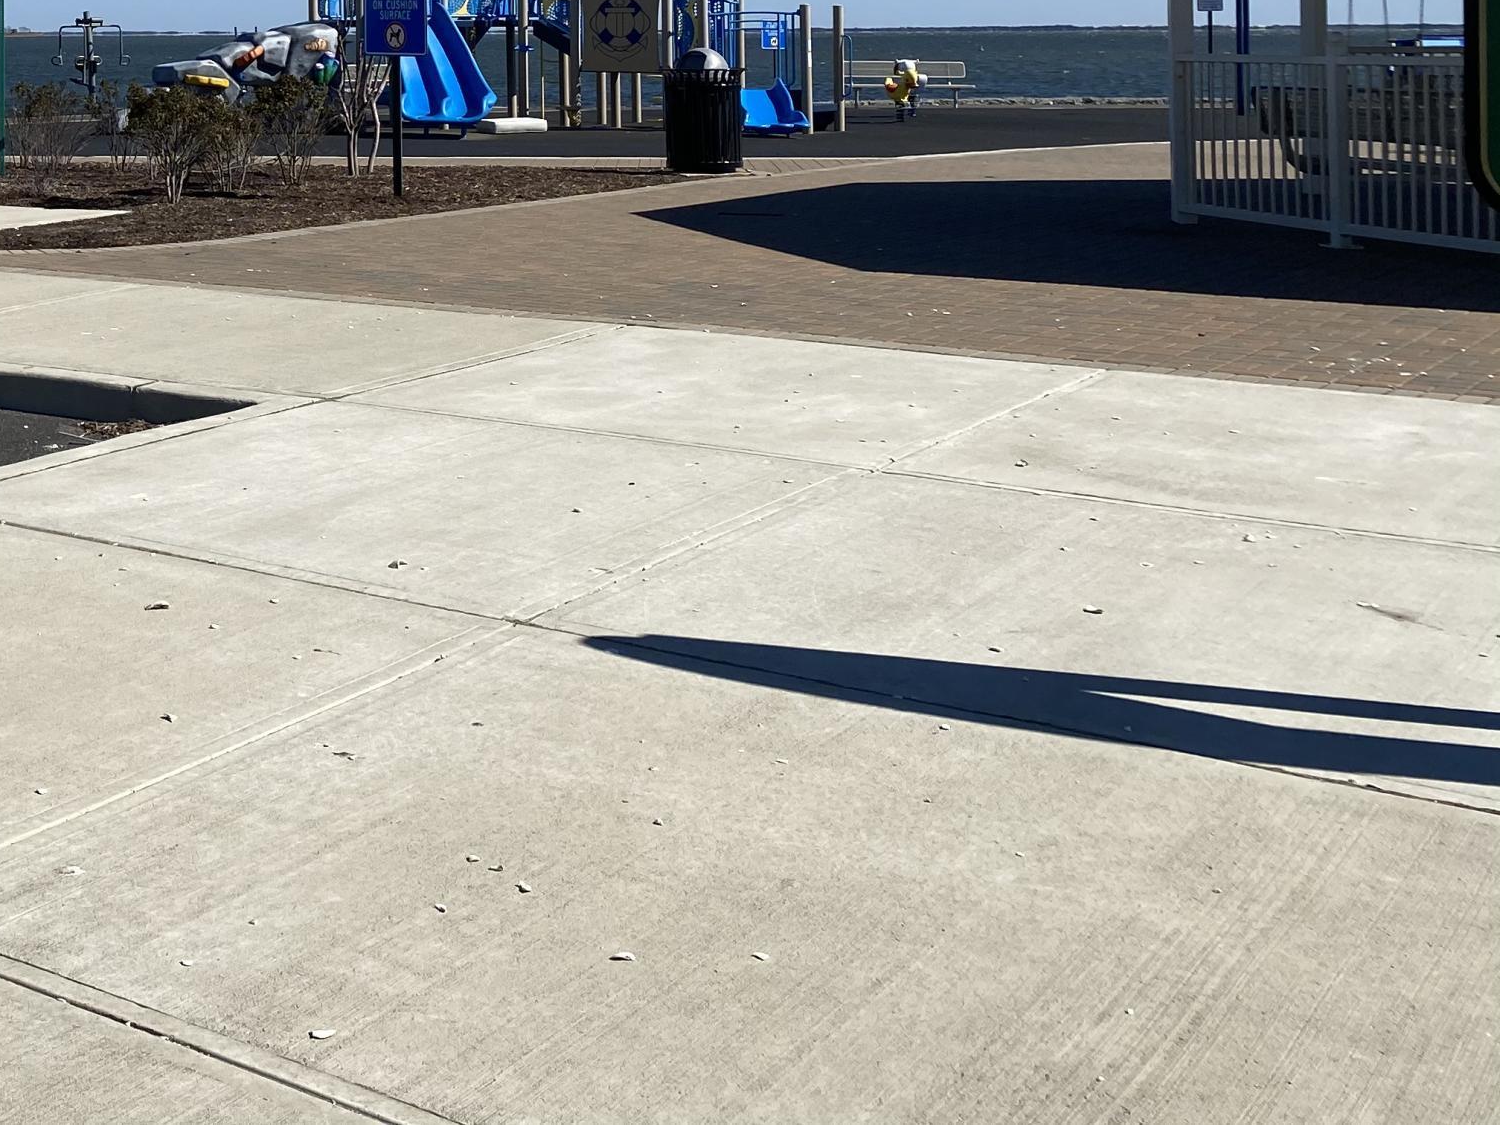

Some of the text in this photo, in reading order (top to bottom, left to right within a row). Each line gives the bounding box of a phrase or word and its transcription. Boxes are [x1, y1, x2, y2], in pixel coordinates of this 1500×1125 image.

[372, 0, 418, 10] ON CUSHION
[379, 10, 411, 20] SURFACE
